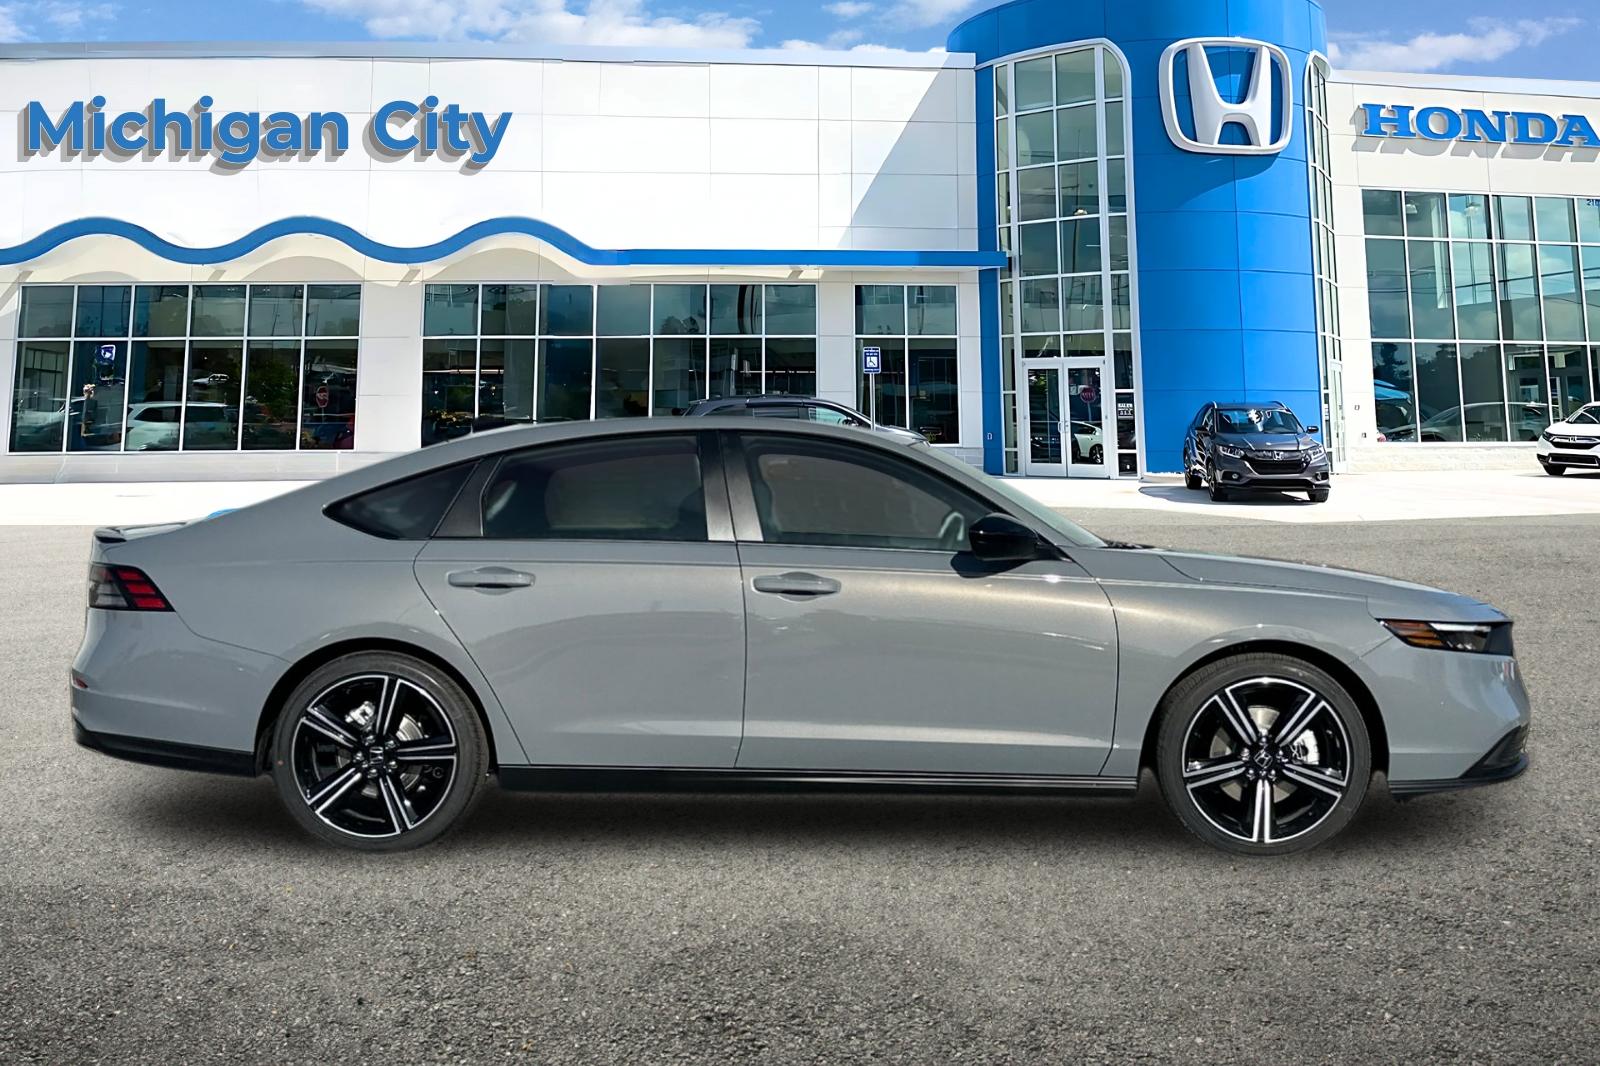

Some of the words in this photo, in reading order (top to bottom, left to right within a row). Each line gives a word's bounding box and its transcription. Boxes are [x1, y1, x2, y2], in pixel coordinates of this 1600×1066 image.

[28, 95, 349, 165] Michigan
[373, 95, 513, 166] City
[1361, 102, 1600, 149] HONDA
